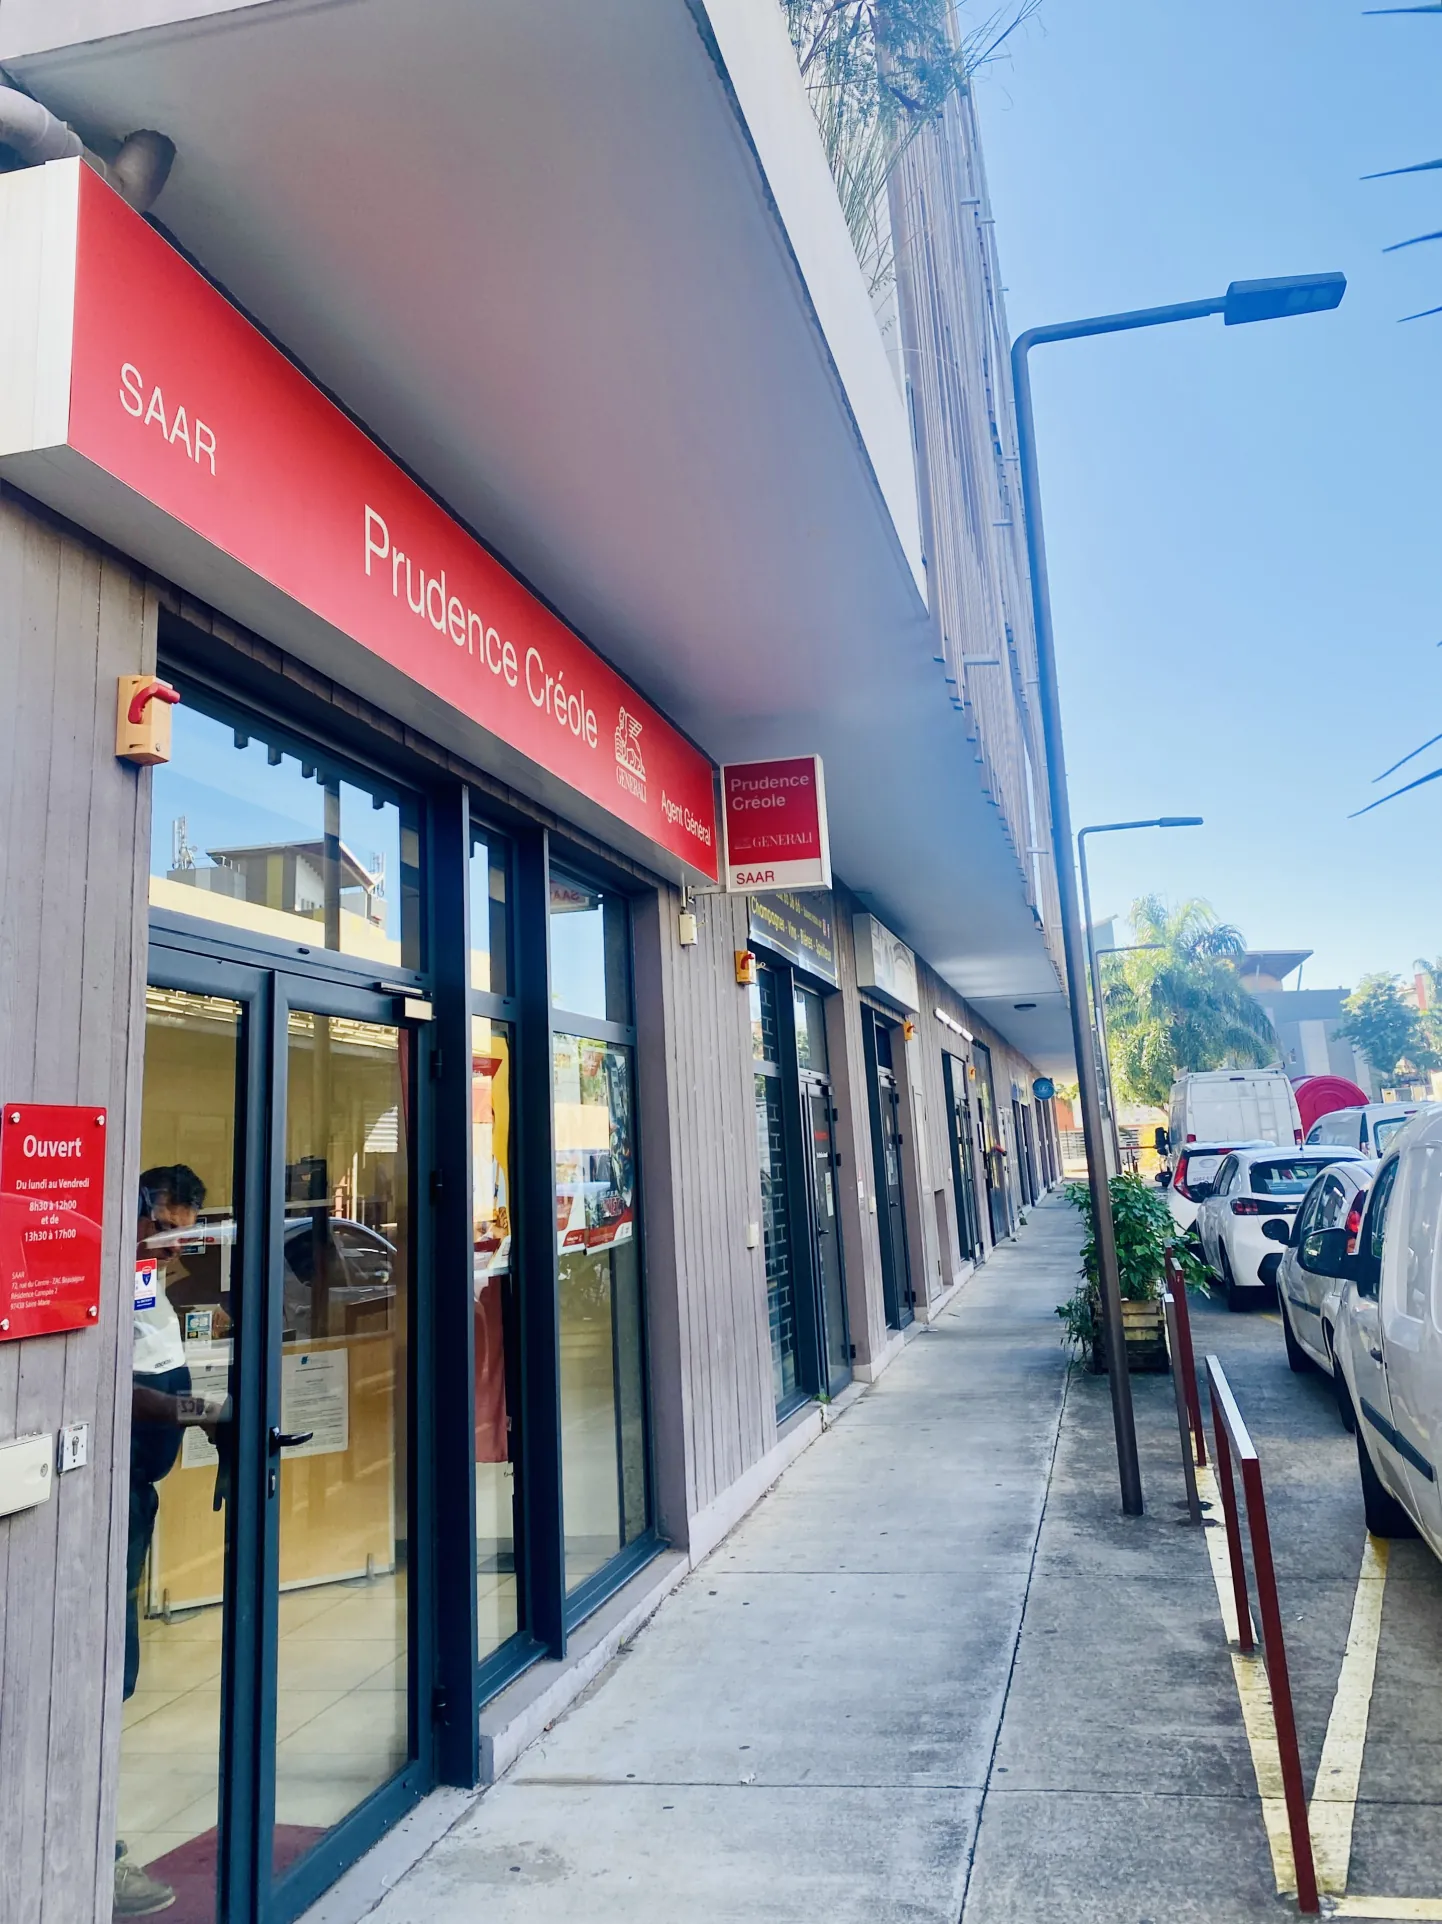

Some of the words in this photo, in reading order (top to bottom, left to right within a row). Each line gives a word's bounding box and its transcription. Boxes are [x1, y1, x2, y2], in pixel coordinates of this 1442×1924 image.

[118, 362, 218, 476] SAAR
[363, 503, 518, 689] Prudence
[524, 646, 599, 749] Créole
[615, 766, 647, 804] GENERALI
[731, 775, 809, 792] Prudence
[732, 793, 786, 811] Créole
[661, 789, 683, 827] Agent
[684, 807, 711, 847] Général
[753, 831, 813, 848] GENERALI
[736, 870, 775, 885] SAAR
[23, 1134, 82, 1158] Ouvert
[16, 1179, 27, 1190] Du
[28, 1178, 47, 1190] lundi
[48, 1180, 58, 1189] au
[58, 1177, 90, 1189] Vendredi
[29, 1200, 48, 1212] 8h30
[55, 1199, 77, 1210] 12h00
[41, 1215, 49, 1225] et
[50, 1213, 59, 1224] de
[24, 1230, 48, 1242] 13h30
[48, 1229, 53, 1240] à
[54, 1228, 77, 1239] 17h00
